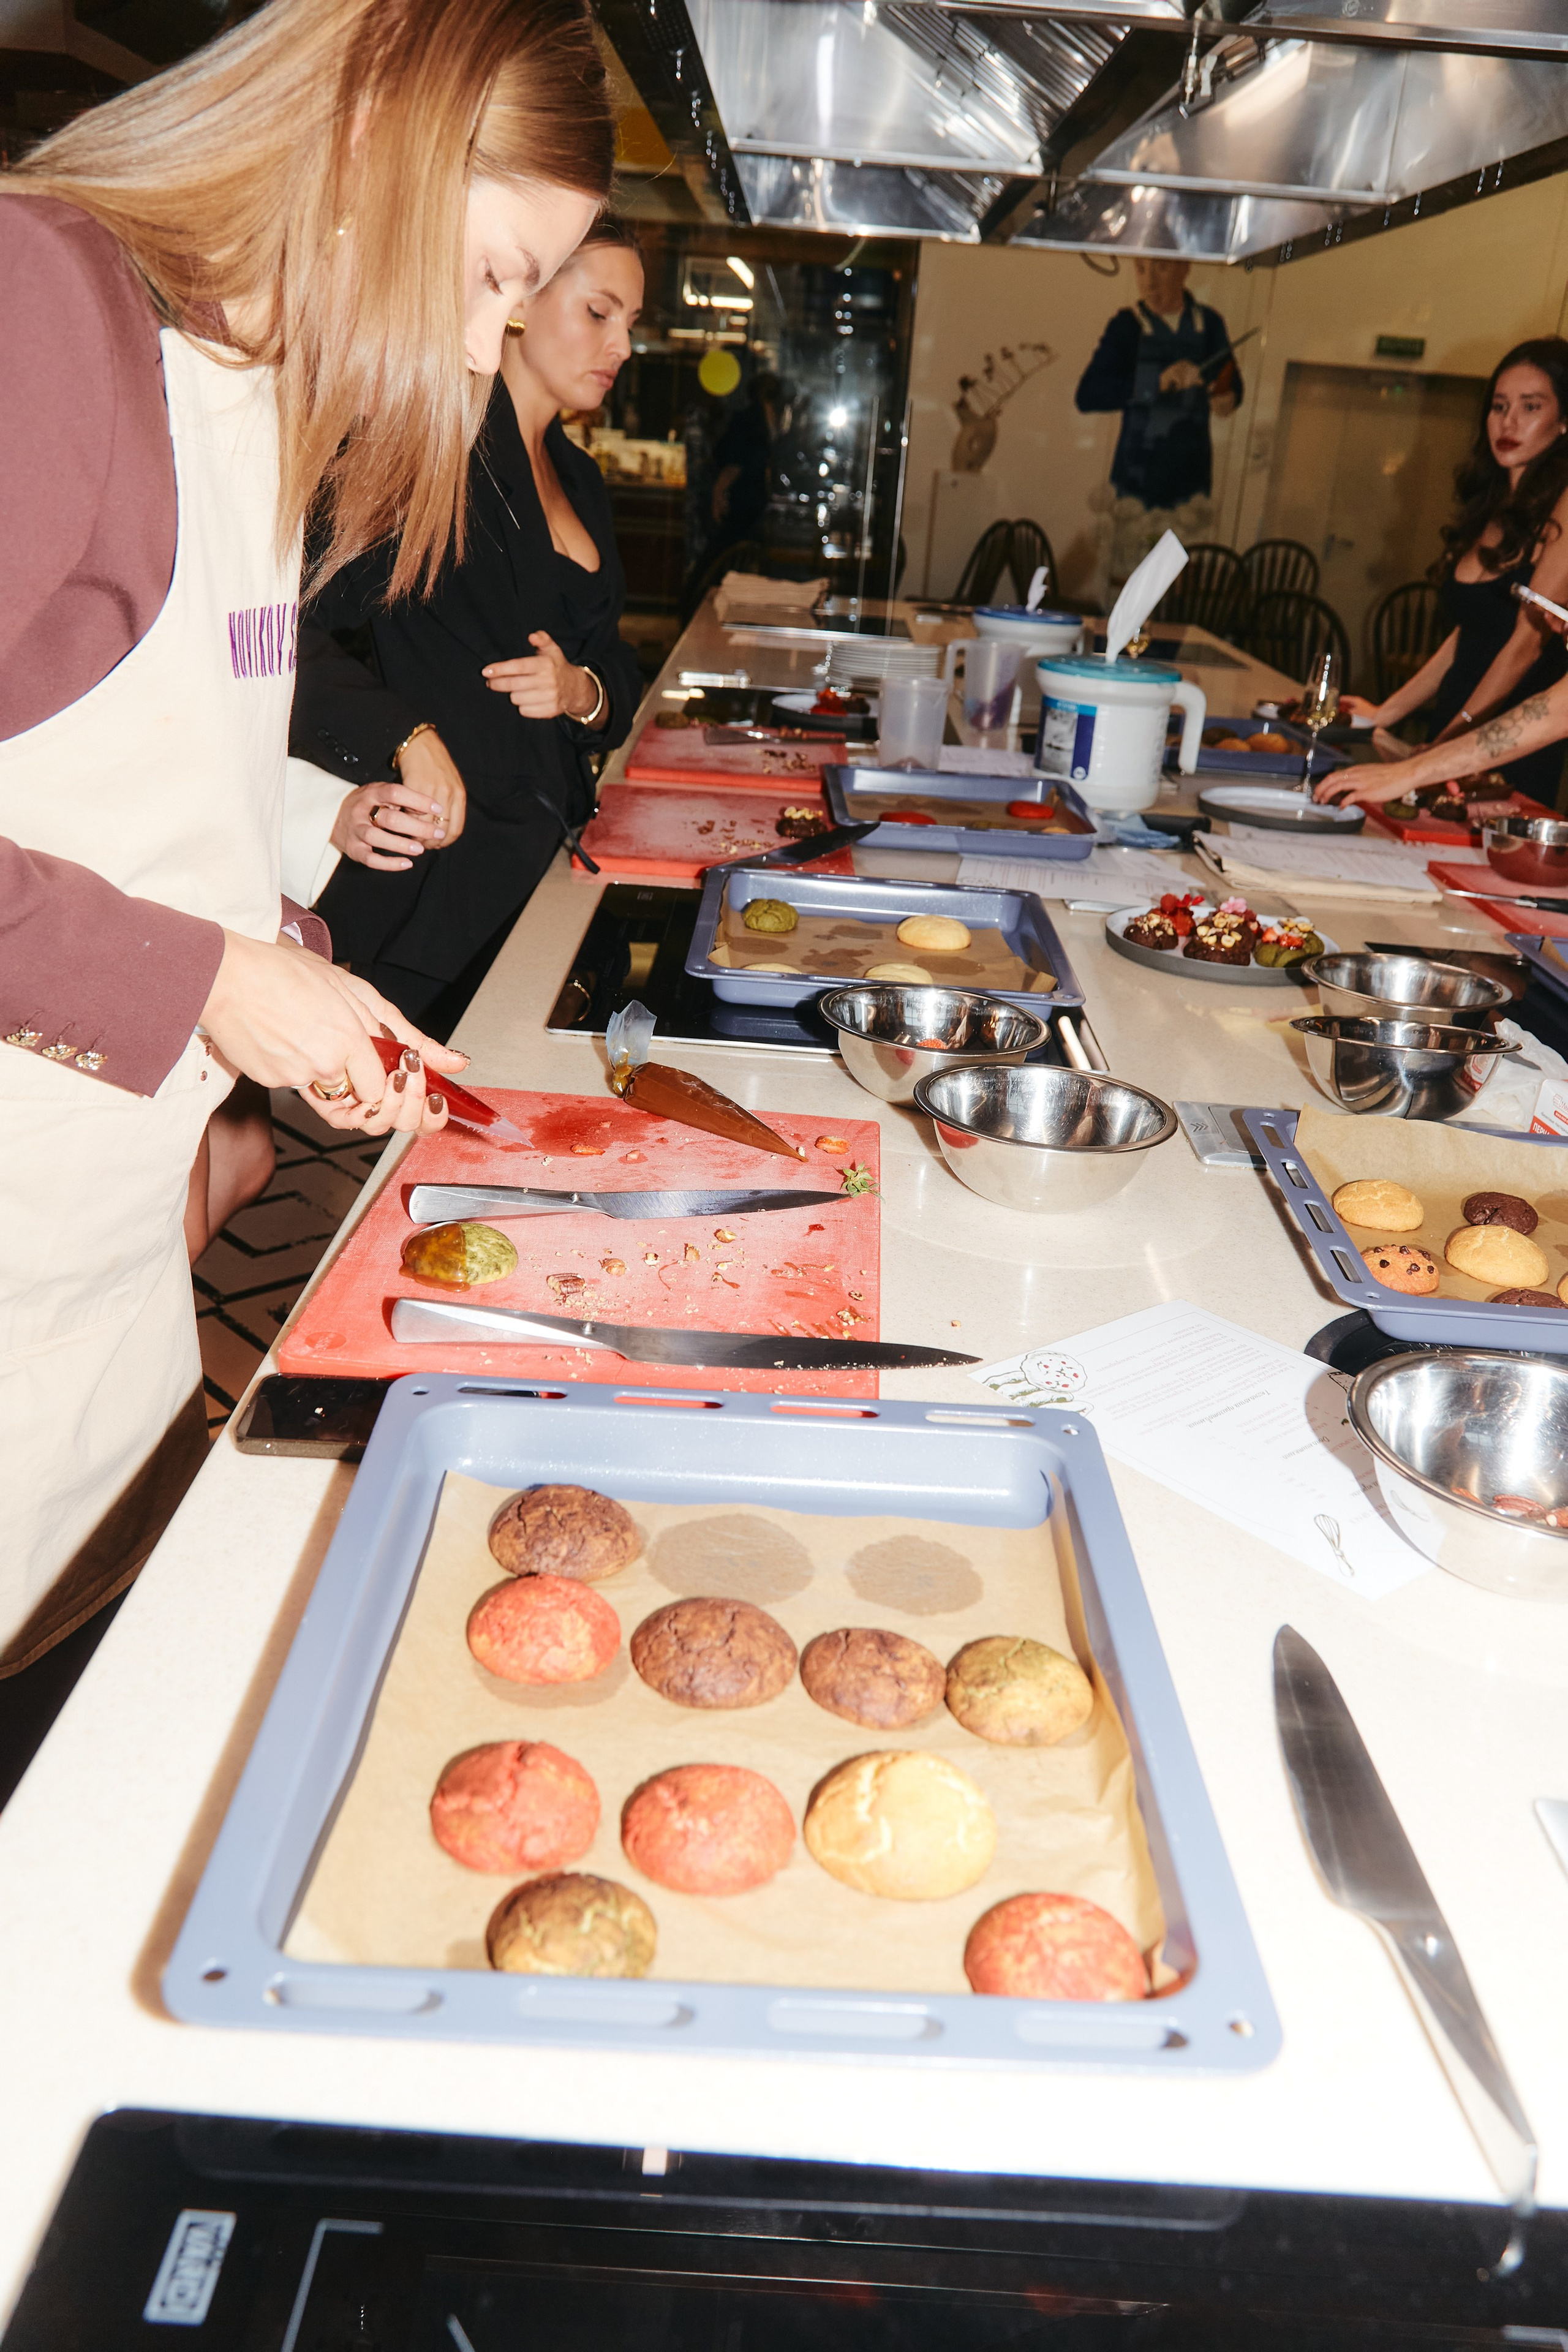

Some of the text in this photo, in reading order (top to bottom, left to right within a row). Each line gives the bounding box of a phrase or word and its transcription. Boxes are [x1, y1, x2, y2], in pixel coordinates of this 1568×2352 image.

[228, 603, 287, 679] NOVIKOV
[1183, 1389, 1272, 1431] Технология приготовления:
[1279, 1434, 1332, 1463] Дополнительно:
